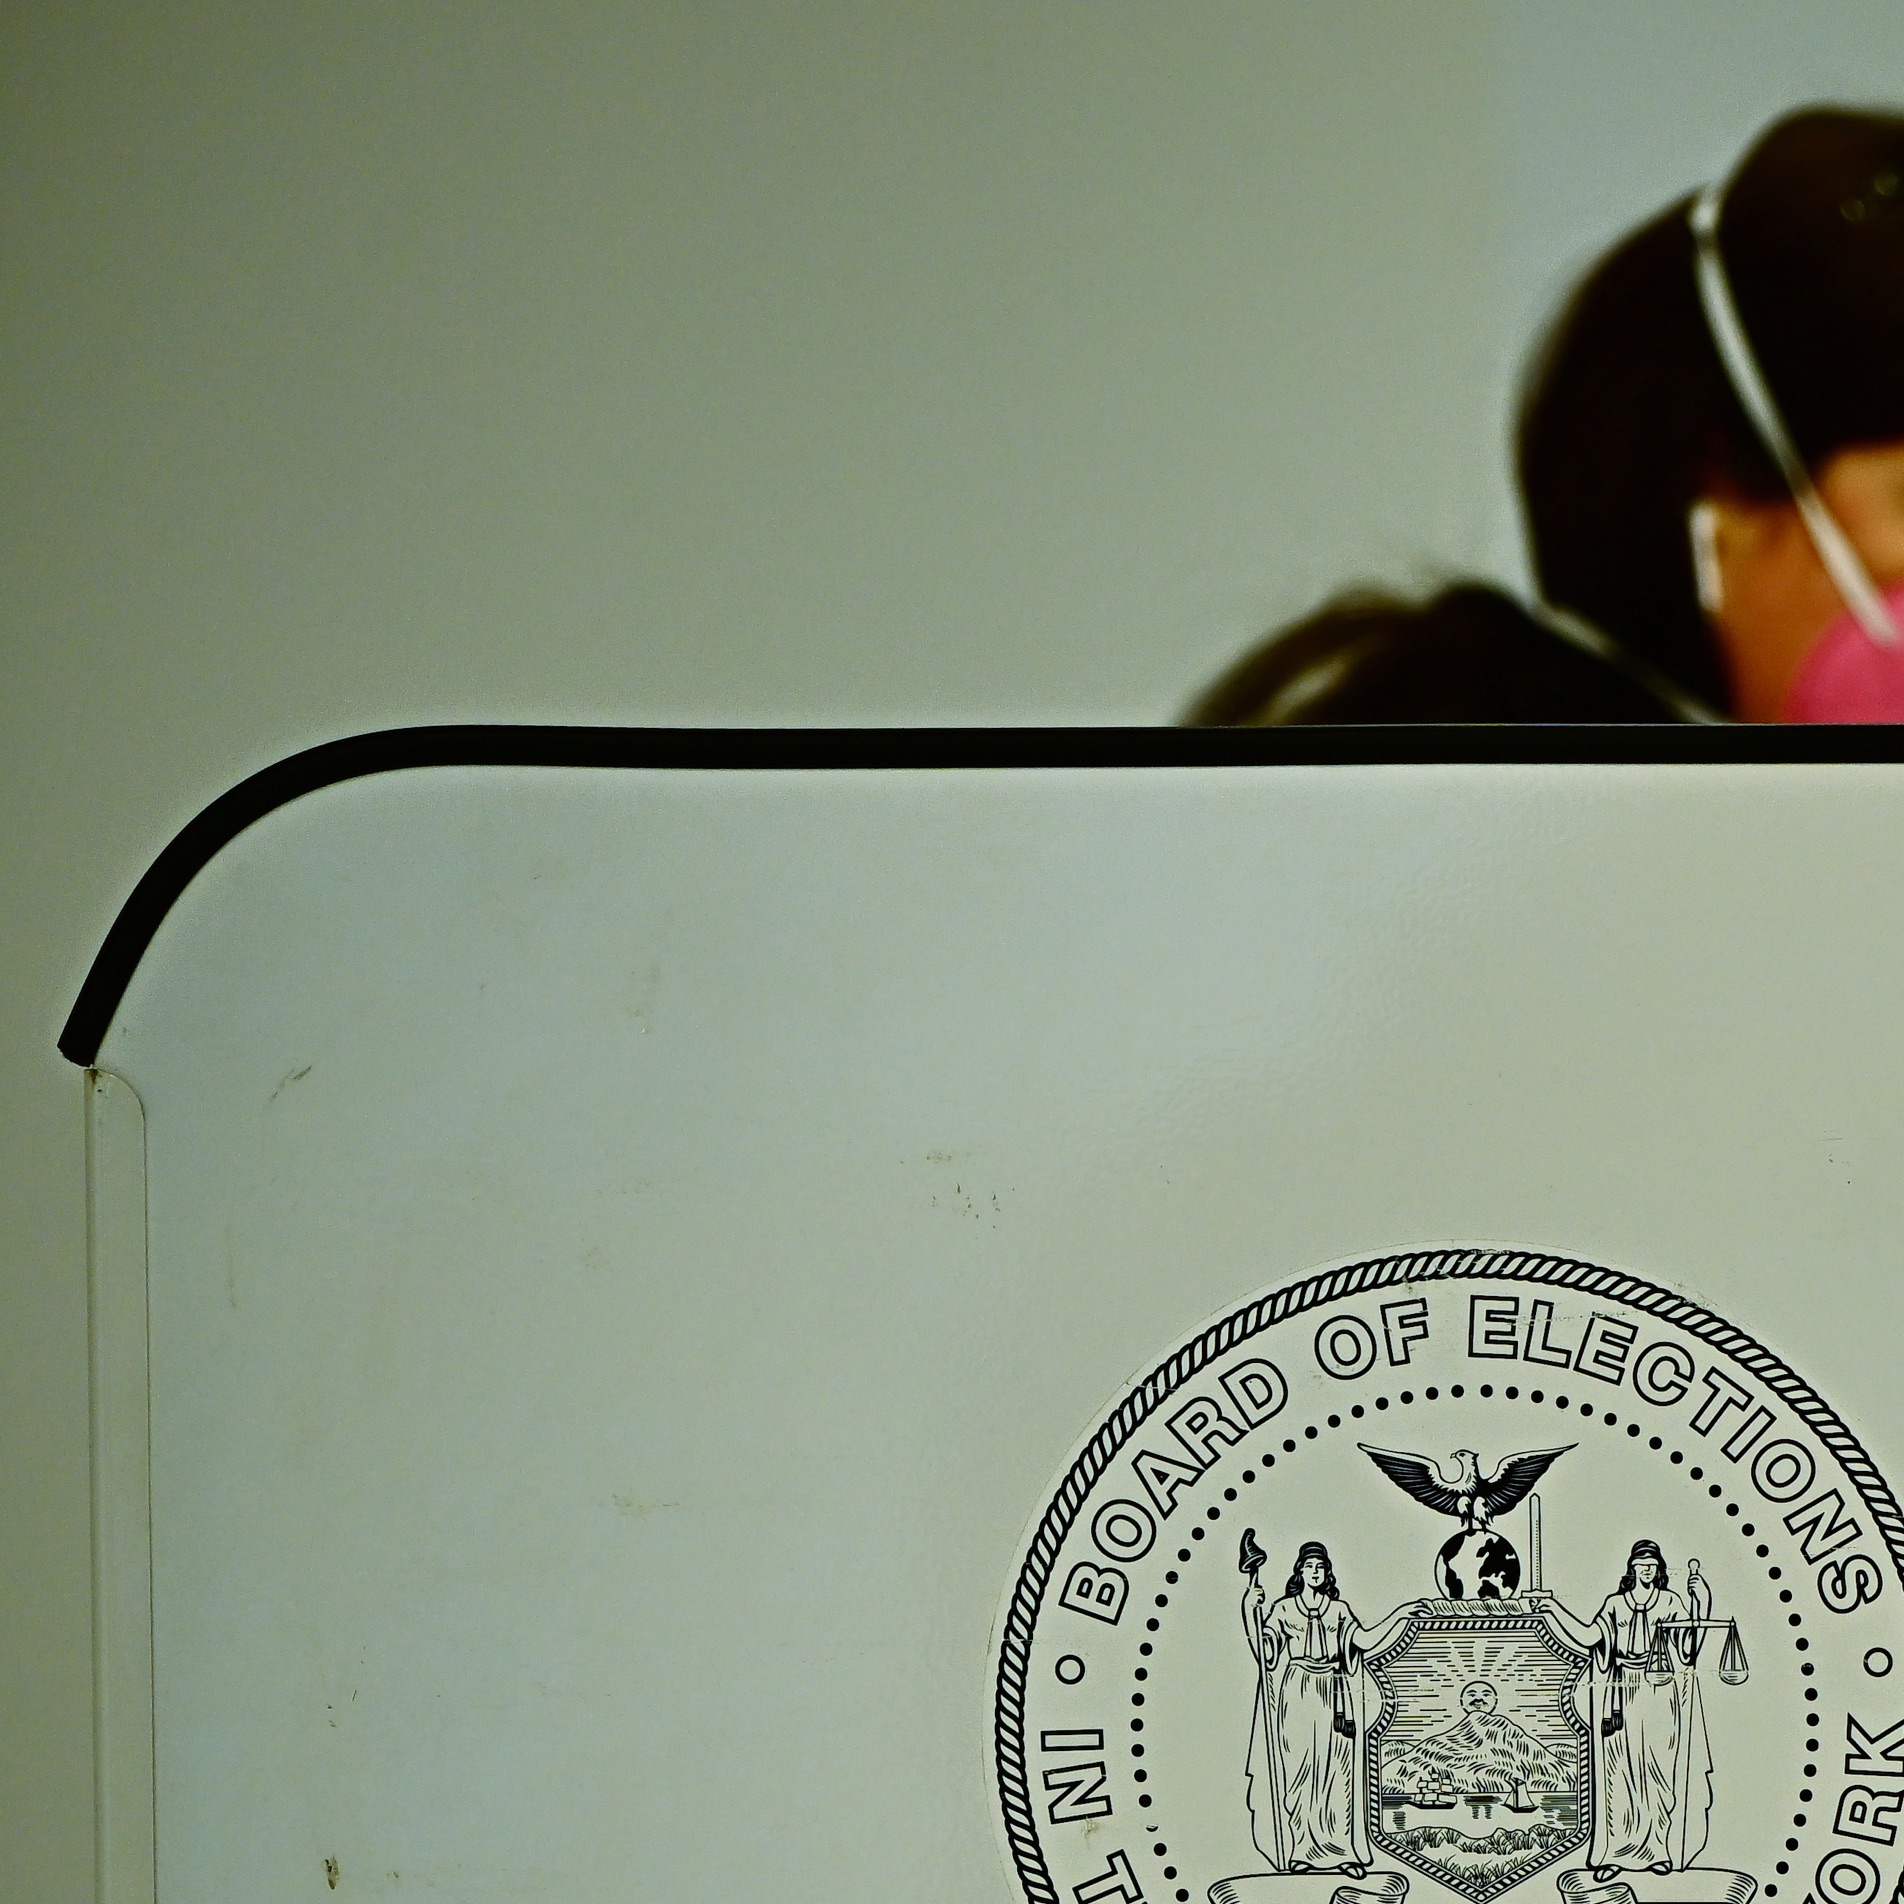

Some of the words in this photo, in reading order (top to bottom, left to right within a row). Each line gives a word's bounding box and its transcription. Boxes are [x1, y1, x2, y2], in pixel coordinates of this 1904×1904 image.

[1061, 1357, 1288, 1627] BOARD
[1313, 1298, 1430, 1381] OF
[1467, 1293, 1886, 1615] ELECTIONS
[1040, 1727, 1114, 1828] IN
